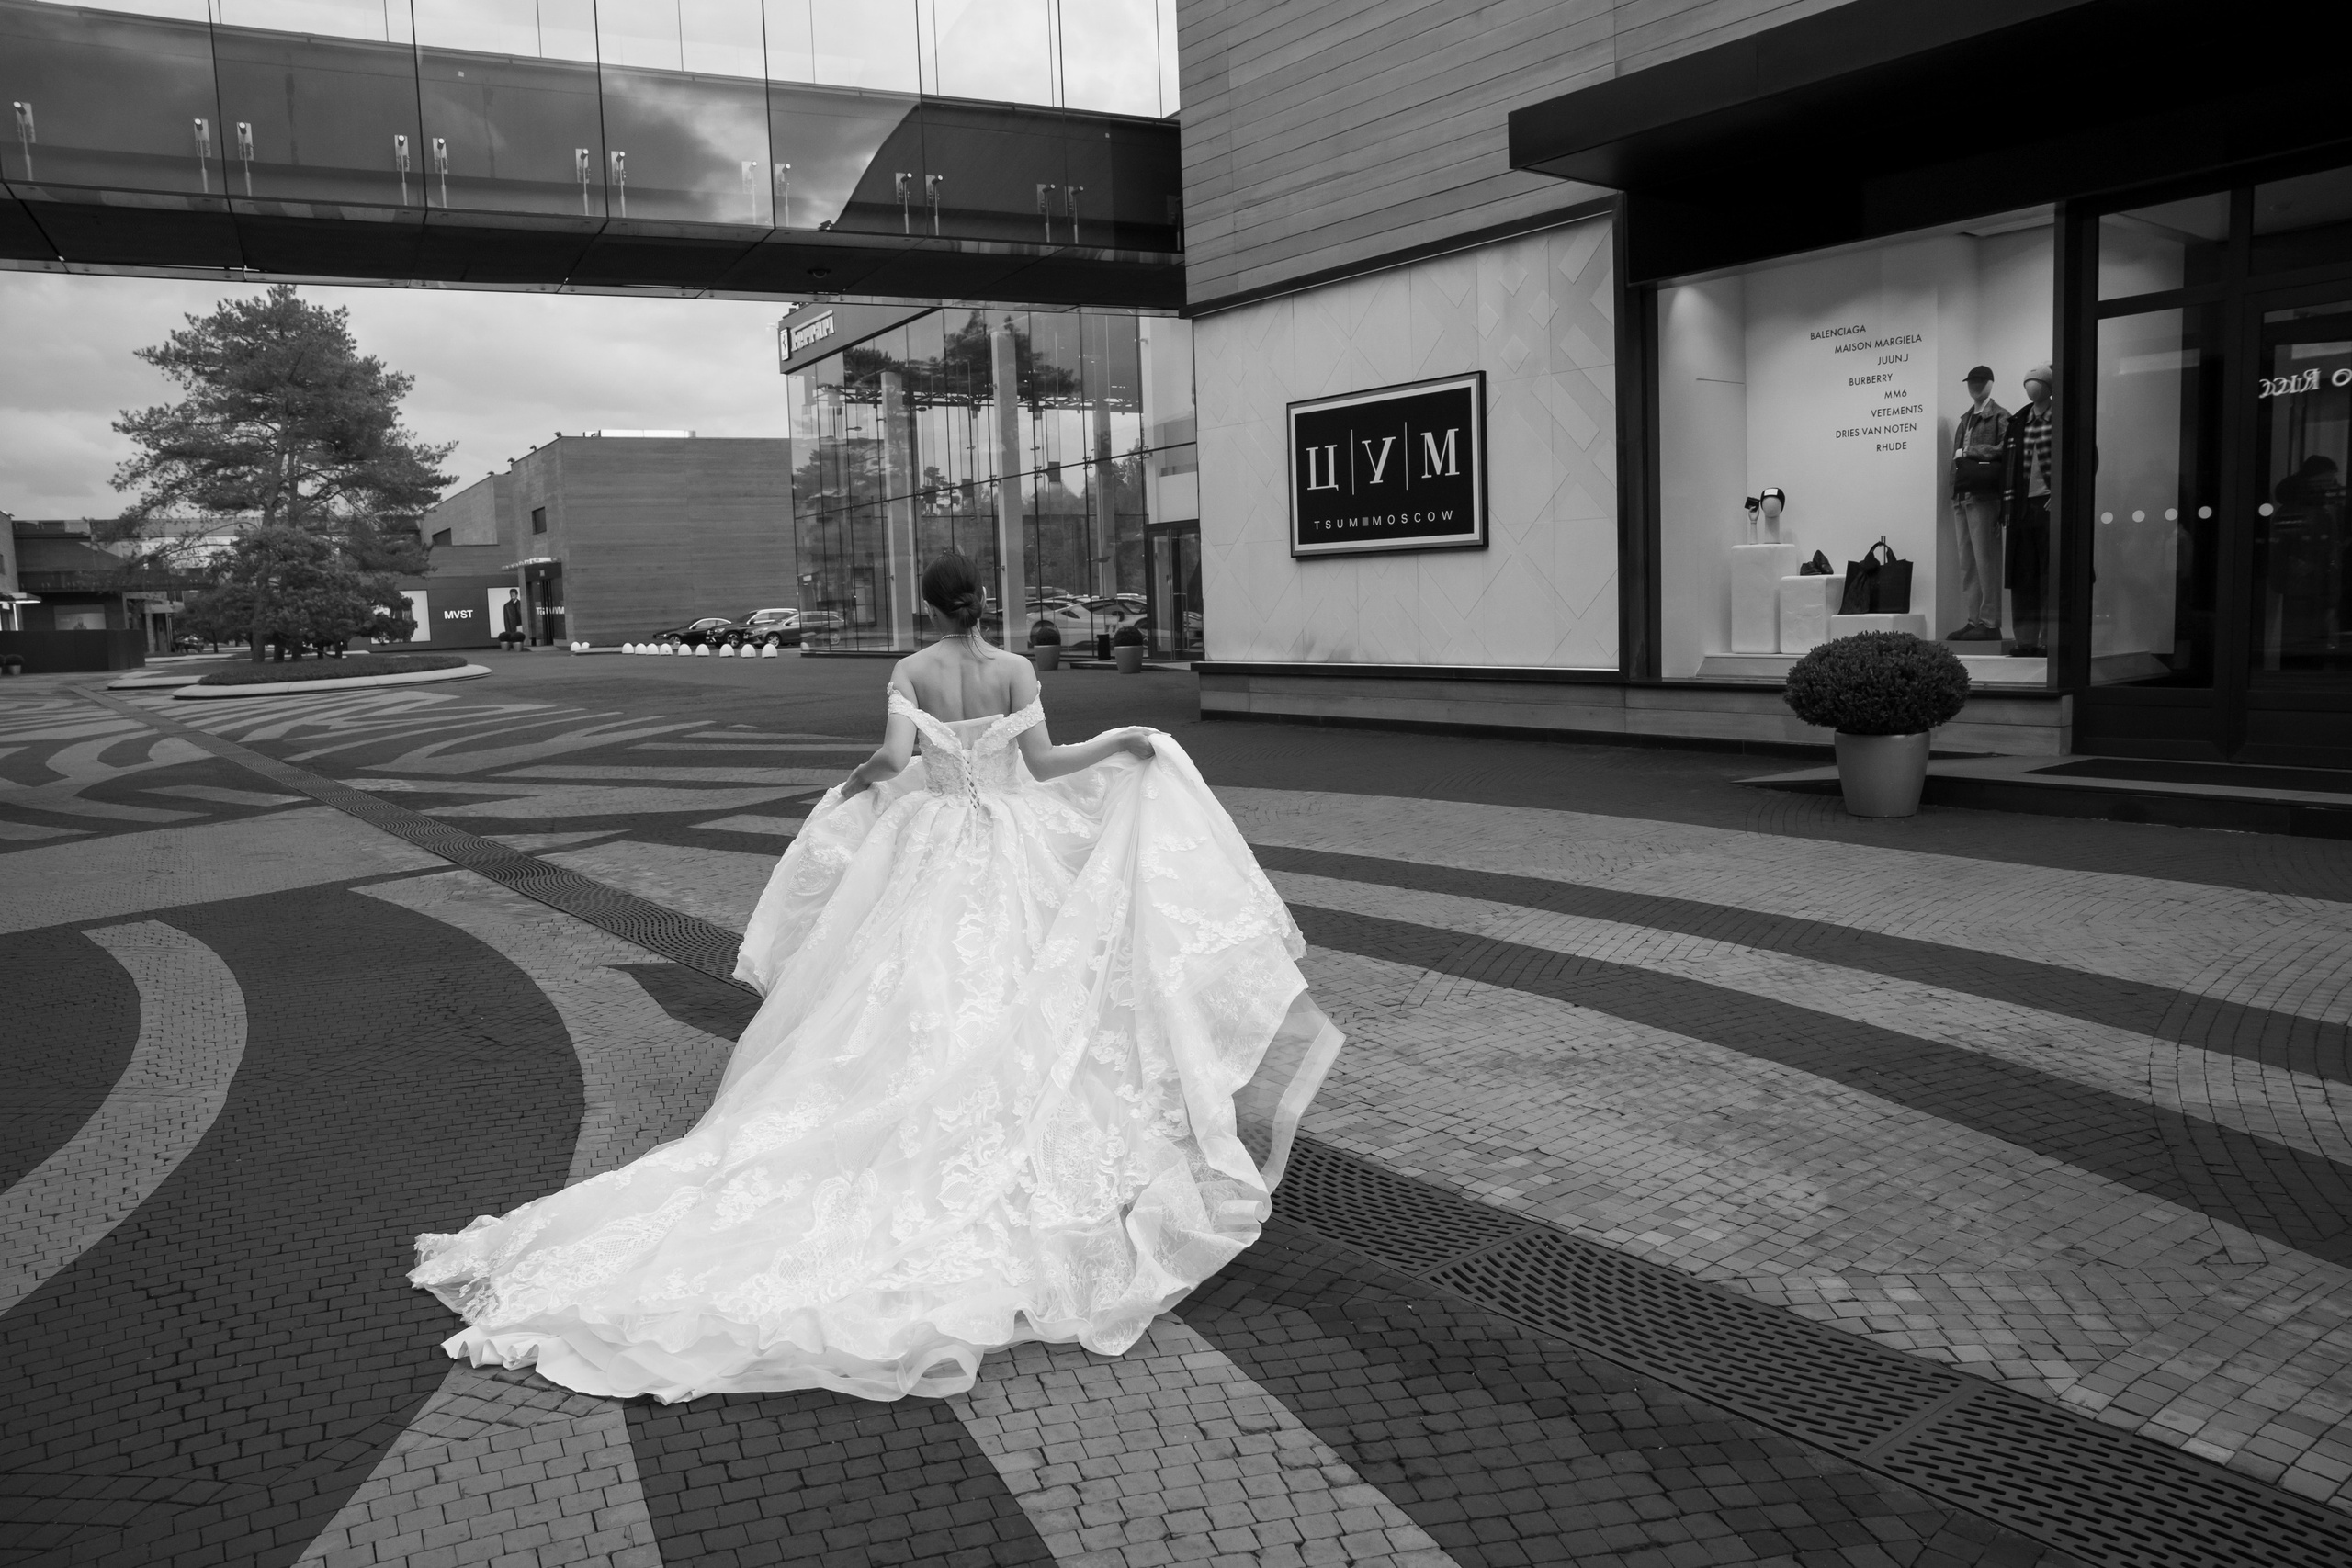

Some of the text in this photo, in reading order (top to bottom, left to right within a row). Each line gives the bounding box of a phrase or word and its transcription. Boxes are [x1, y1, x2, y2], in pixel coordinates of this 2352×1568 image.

[1810, 324, 1866, 340] BALENCIAGA
[1834, 333, 1922, 354] MAISON MARGIELA
[1877, 354, 1909, 365] JUUN.J
[1849, 373, 1894, 386] BURBERRY
[1883, 389, 1907, 399] MM6
[1871, 404, 1924, 417] VETEMENTS
[1835, 423, 1917, 438] DRIES VAN NOTEN
[1876, 441, 1907, 451] RHUDE
[1314, 510, 1453, 529] TSUM MOSCOW
[443, 609, 474, 619] MVST
